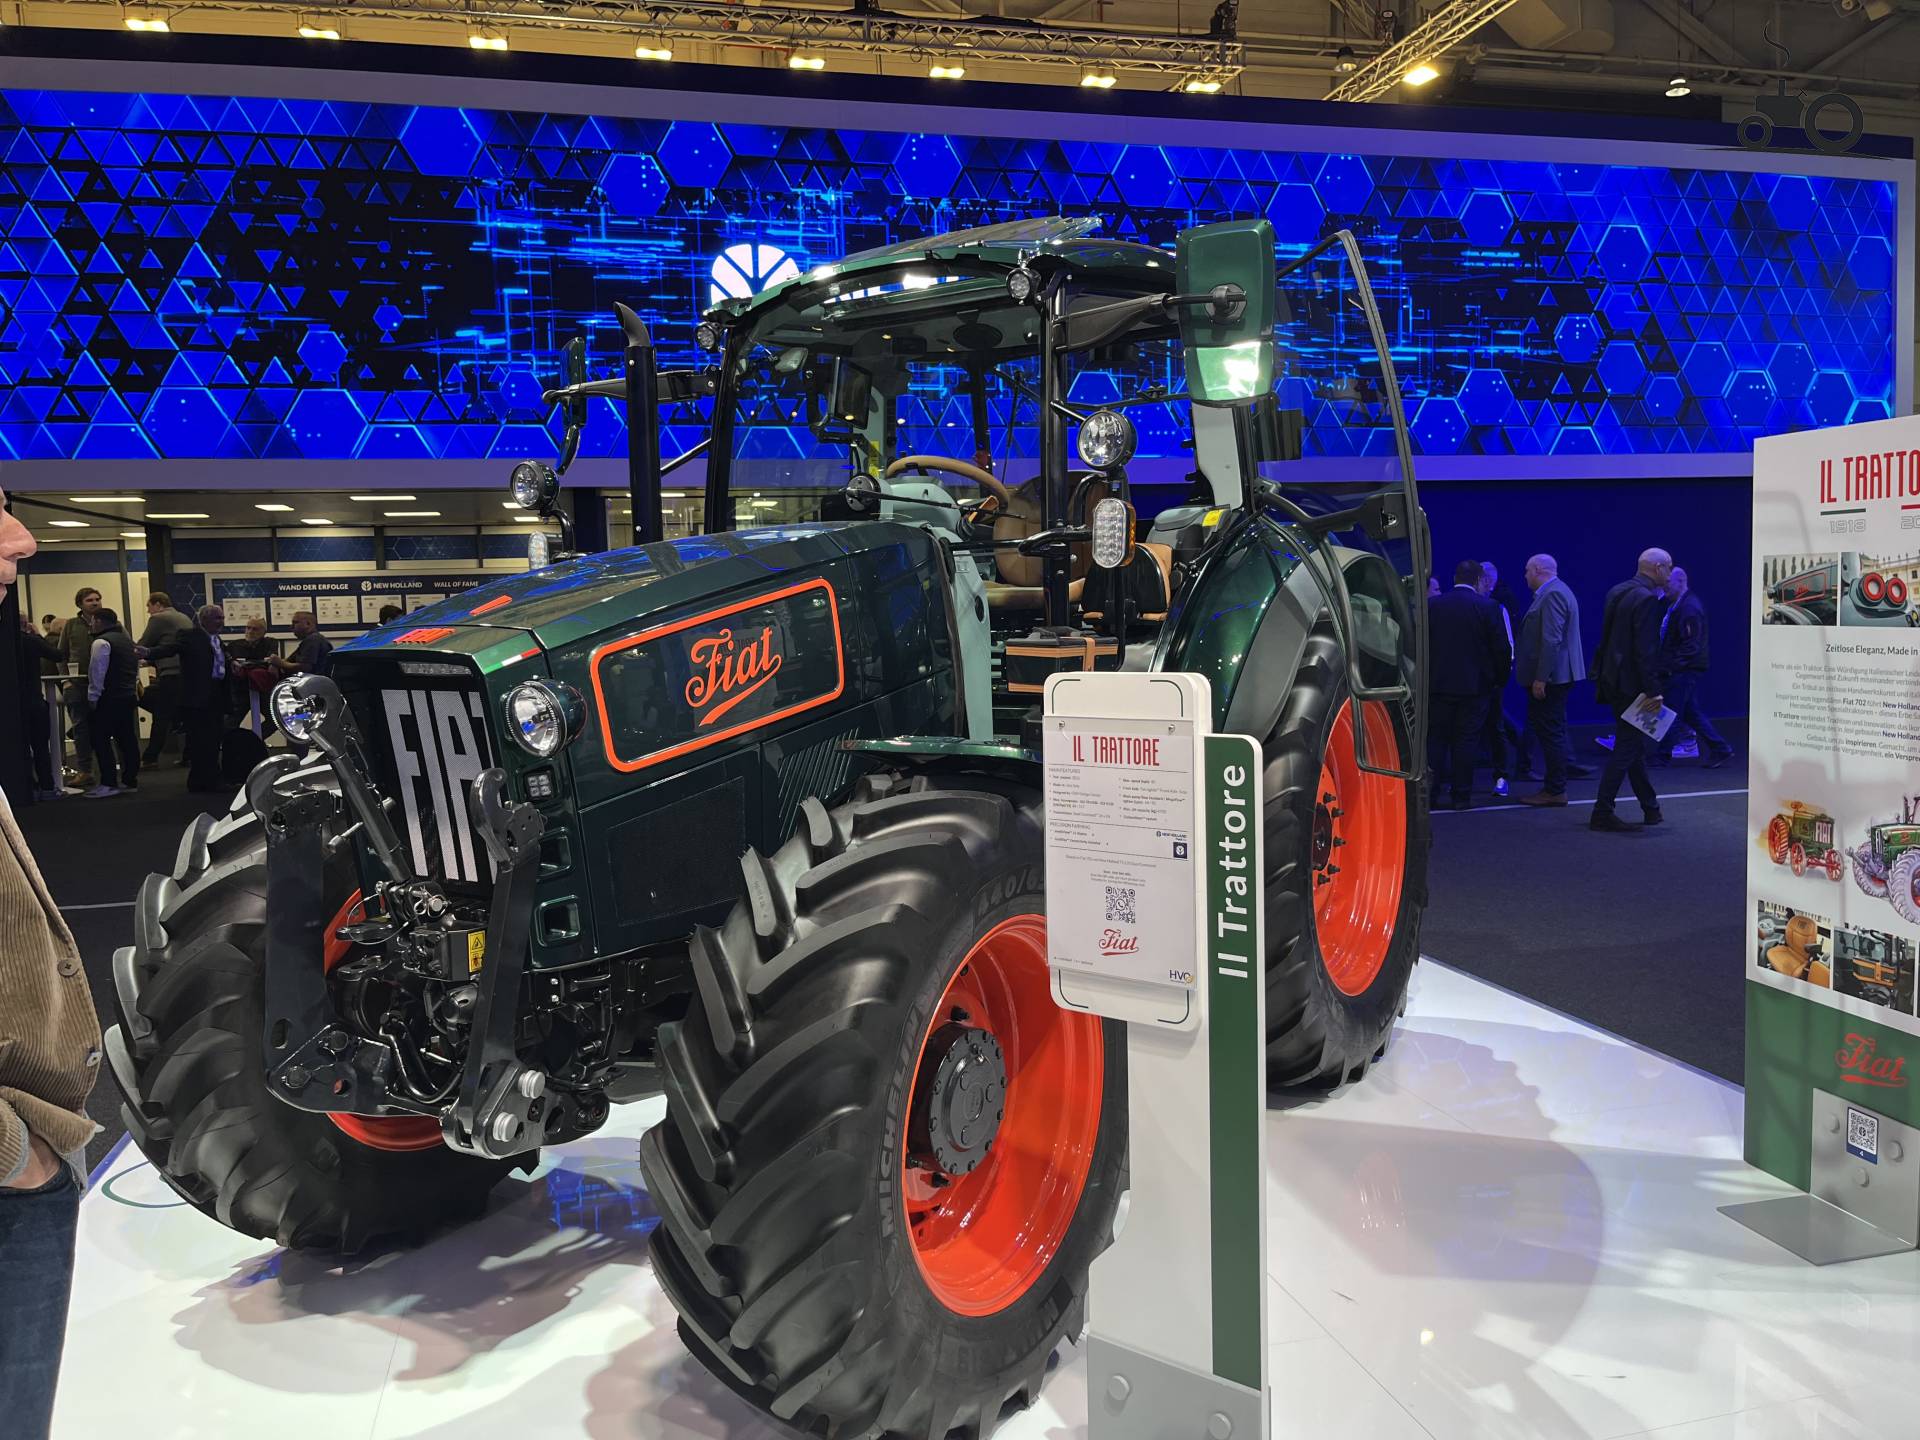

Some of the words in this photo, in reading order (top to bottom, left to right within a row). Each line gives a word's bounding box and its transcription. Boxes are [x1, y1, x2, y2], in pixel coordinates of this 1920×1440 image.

[1820, 460, 1837, 503] IL
[1843, 450, 1920, 501] TRATTO
[1830, 519, 1866, 533] 1918
[1825, 644, 1854, 654] Zeitlose
[1856, 645, 1886, 655] Eleganz,
[1887, 647, 1909, 655] Made
[1911, 646, 1918, 656] in
[685, 626, 782, 727] Fiat
[1073, 736, 1085, 762] IL
[1092, 736, 1160, 766] TRATTORE
[1815, 821, 1832, 844] FIAT
[1217, 764, 1247, 938] Trattore
[1099, 928, 1139, 956] Fiat
[1217, 952, 1248, 978] Il
[1835, 1032, 1908, 1088] Fiat
